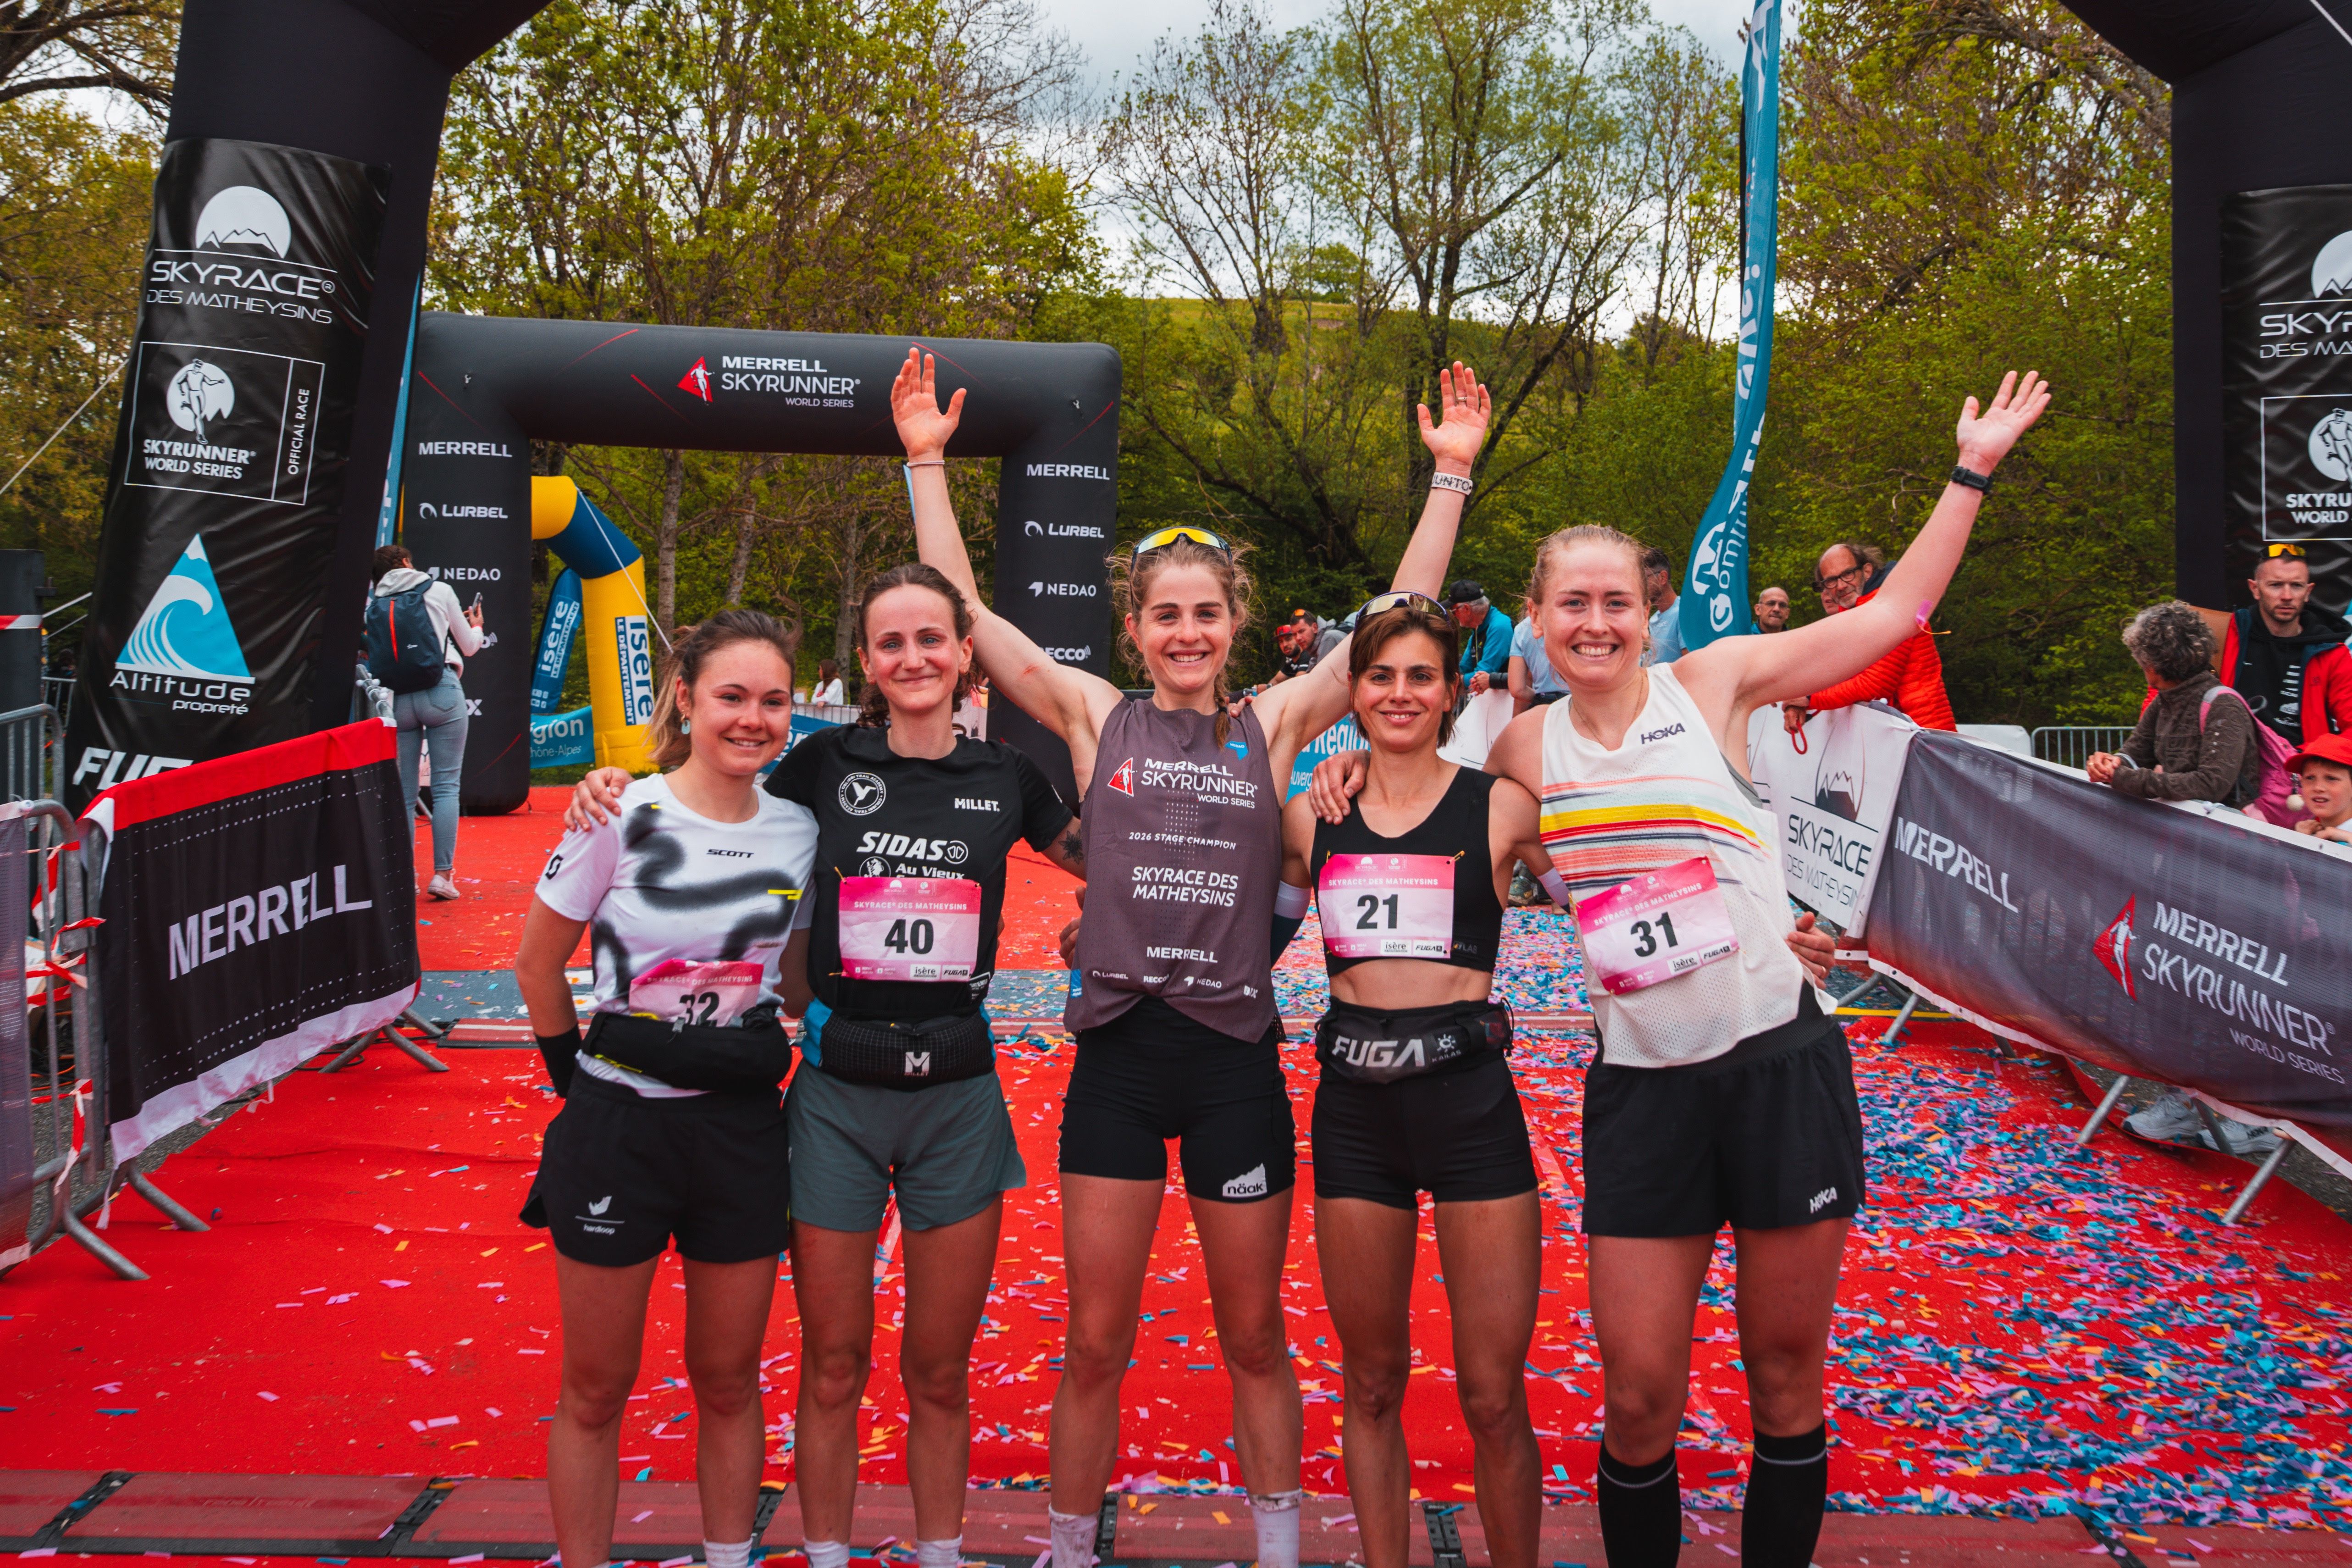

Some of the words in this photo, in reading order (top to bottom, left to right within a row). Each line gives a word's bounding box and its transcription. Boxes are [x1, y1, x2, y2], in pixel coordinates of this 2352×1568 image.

[146, 290, 183, 304] DES
[186, 291, 332, 324] MATHEYSINS
[2260, 343, 2308, 358] DES
[722, 356, 827, 372] MERRELL
[295, 388, 310, 420] RACE
[785, 397, 820, 407] WORLD
[823, 399, 854, 408] SERIES
[287, 421, 306, 476] OFFICIAL
[418, 441, 513, 458] MERRELL
[144, 457, 190, 474] WORLD
[192, 462, 243, 480] SERIES
[1027, 464, 1110, 480] MERRELL
[442, 504, 508, 519] LURBEL
[2291, 511, 2349, 523] WORLD
[1048, 523, 1104, 538] LURBEL
[443, 567, 501, 581] NEDAO
[1047, 583, 1096, 597] NEDAO
[617, 619, 625, 632] LE
[1040, 647, 1085, 660] ECCO
[109, 670, 251, 702] Altitude
[172, 699, 249, 715] propreté
[530, 719, 584, 744] gion
[1641, 722, 1686, 744] HOKA
[531, 744, 581, 758] hône-Alpes
[72, 747, 194, 790] FU
[1144, 758, 1233, 776] MERRELL
[1197, 793, 1229, 804] WORLD
[1231, 798, 1255, 809] SERIES
[857, 831, 948, 861] SIDAS
[1129, 832, 1151, 841] 2026
[1155, 833, 1184, 843] STAGE
[1187, 837, 1236, 850] CHAMPION
[1788, 814, 1872, 877] SKYRACE
[707, 848, 754, 859] SCOTT
[895, 863, 917, 875] Au
[922, 866, 964, 879] Vieux
[1894, 816, 2019, 913] MERRELL
[1132, 866, 1205, 885] SKYRACE
[1208, 872, 1239, 889] DES
[1133, 884, 1235, 907] MATHEYSINS
[1634, 901, 1649, 911] DES
[1651, 882, 1702, 906] MATHEYSINS
[169, 864, 372, 980] MERRELL
[1356, 894, 1399, 930] 21
[885, 919, 934, 954] 40
[1630, 911, 1678, 958] 31
[2153, 901, 2289, 986] MERRELL
[1146, 947, 1218, 963] MERRELL
[1196, 978, 1222, 988] NEDAO
[679, 992, 719, 1026] 32
[1332, 1035, 1425, 1068] FUGA
[1432, 1050, 1461, 1063] KAILAS
[2229, 1027, 2286, 1063] WORLD
[2288, 1052, 2345, 1084] SERIES
[1228, 1183, 1263, 1195] näak
[1809, 1186, 1837, 1214] HOKA
